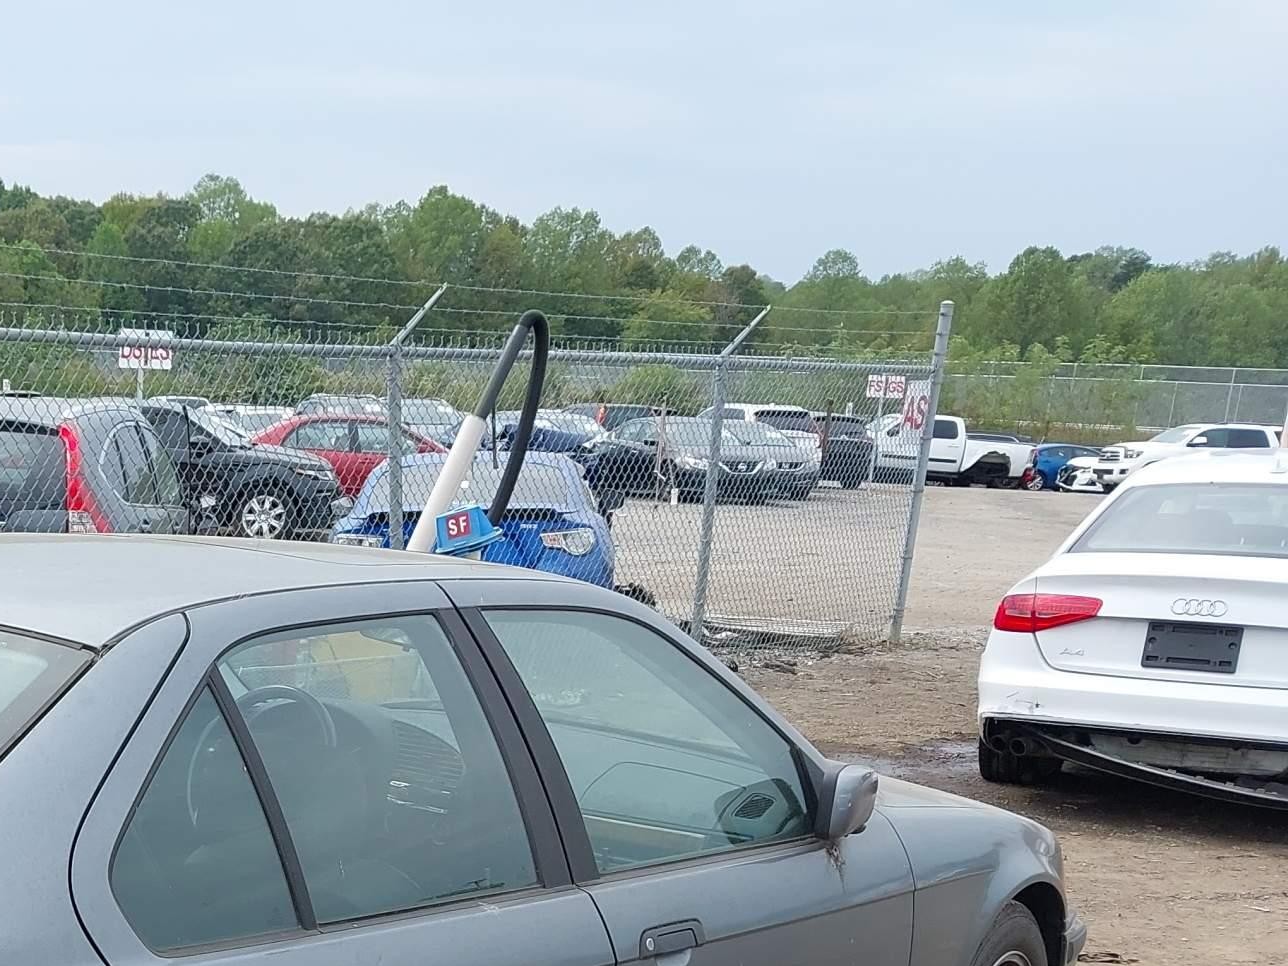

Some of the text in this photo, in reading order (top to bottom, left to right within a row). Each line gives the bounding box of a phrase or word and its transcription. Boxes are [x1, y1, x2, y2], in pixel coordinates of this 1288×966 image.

[868, 380, 904, 393] FS GS
[901, 395, 928, 430] AS
[448, 516, 467, 535] SF
